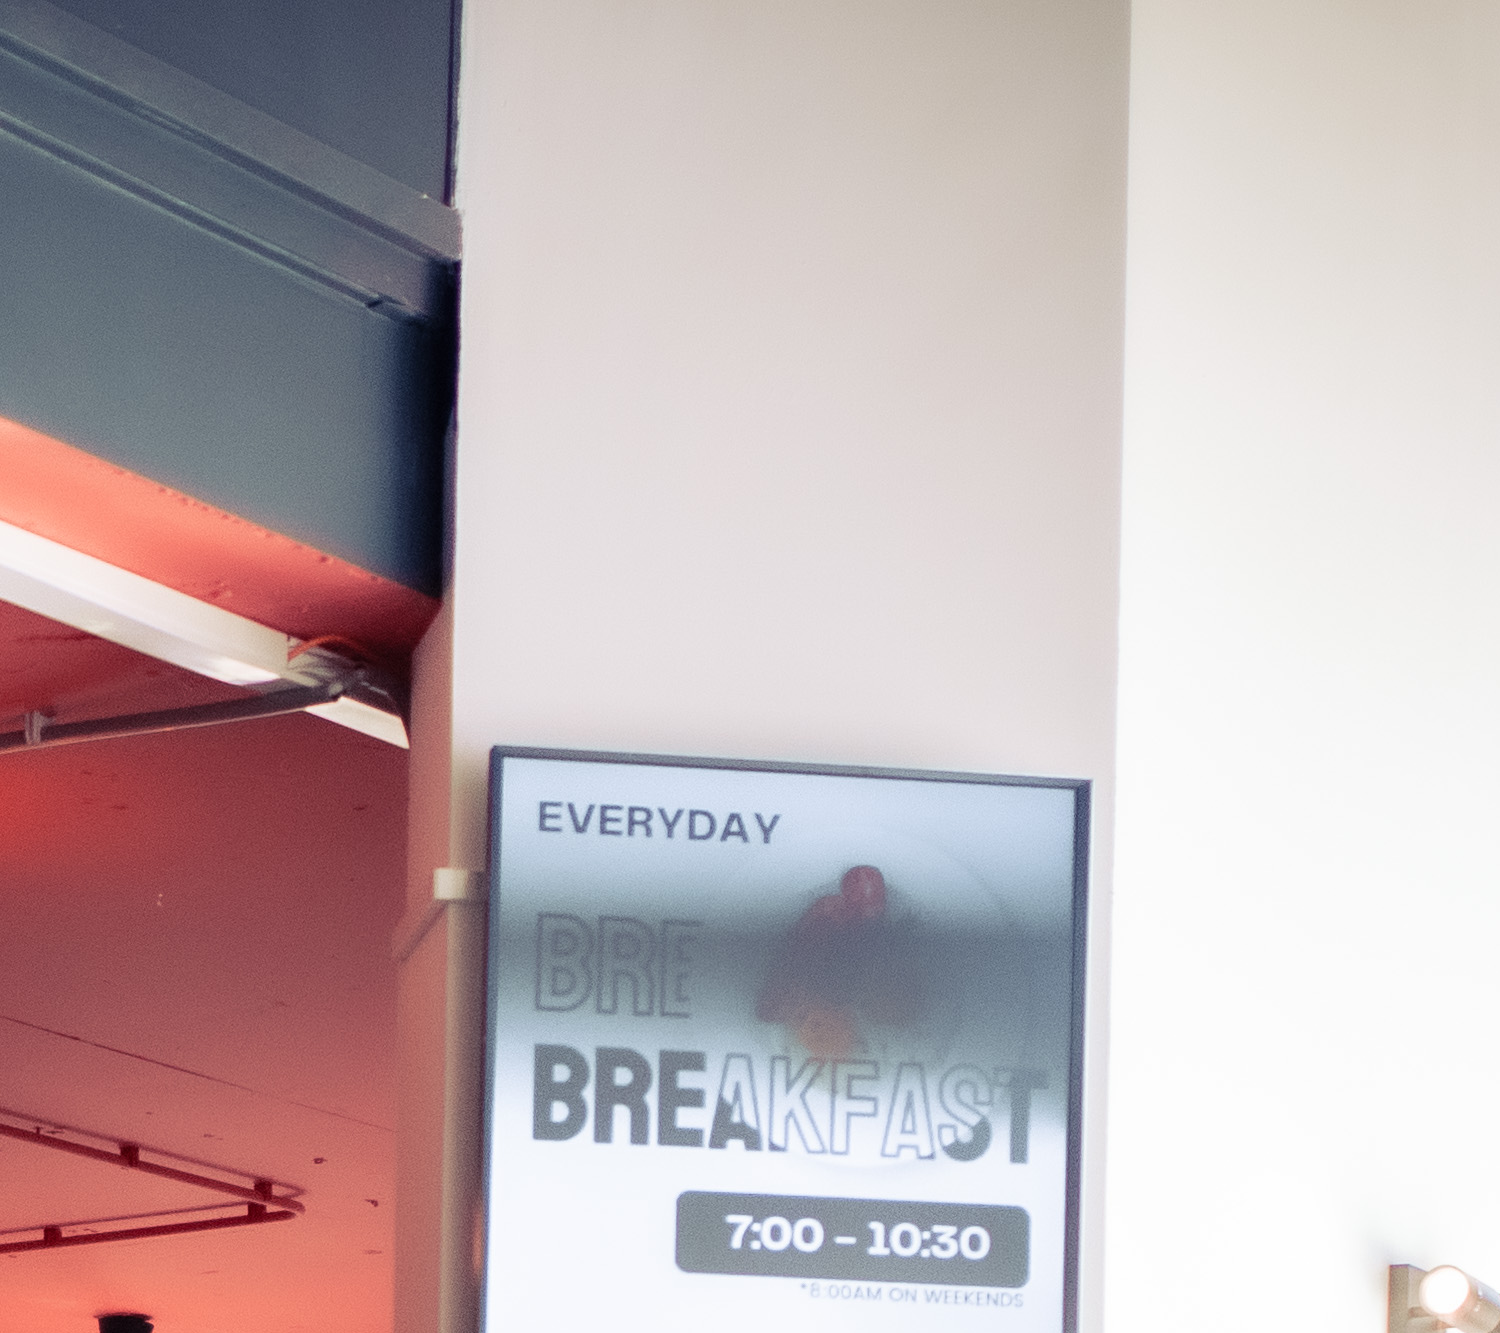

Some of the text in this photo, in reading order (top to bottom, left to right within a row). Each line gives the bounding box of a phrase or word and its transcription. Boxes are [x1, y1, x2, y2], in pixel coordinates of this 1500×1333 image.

[536, 800, 782, 844] EVERYDAY
[531, 1043, 1050, 1164] BREAKFAST
[725, 1213, 825, 1253] 7:00
[866, 1220, 992, 1261] 10:30
[888, 1286, 918, 1303] ON
[924, 1289, 1025, 1308] WEEKENDS
